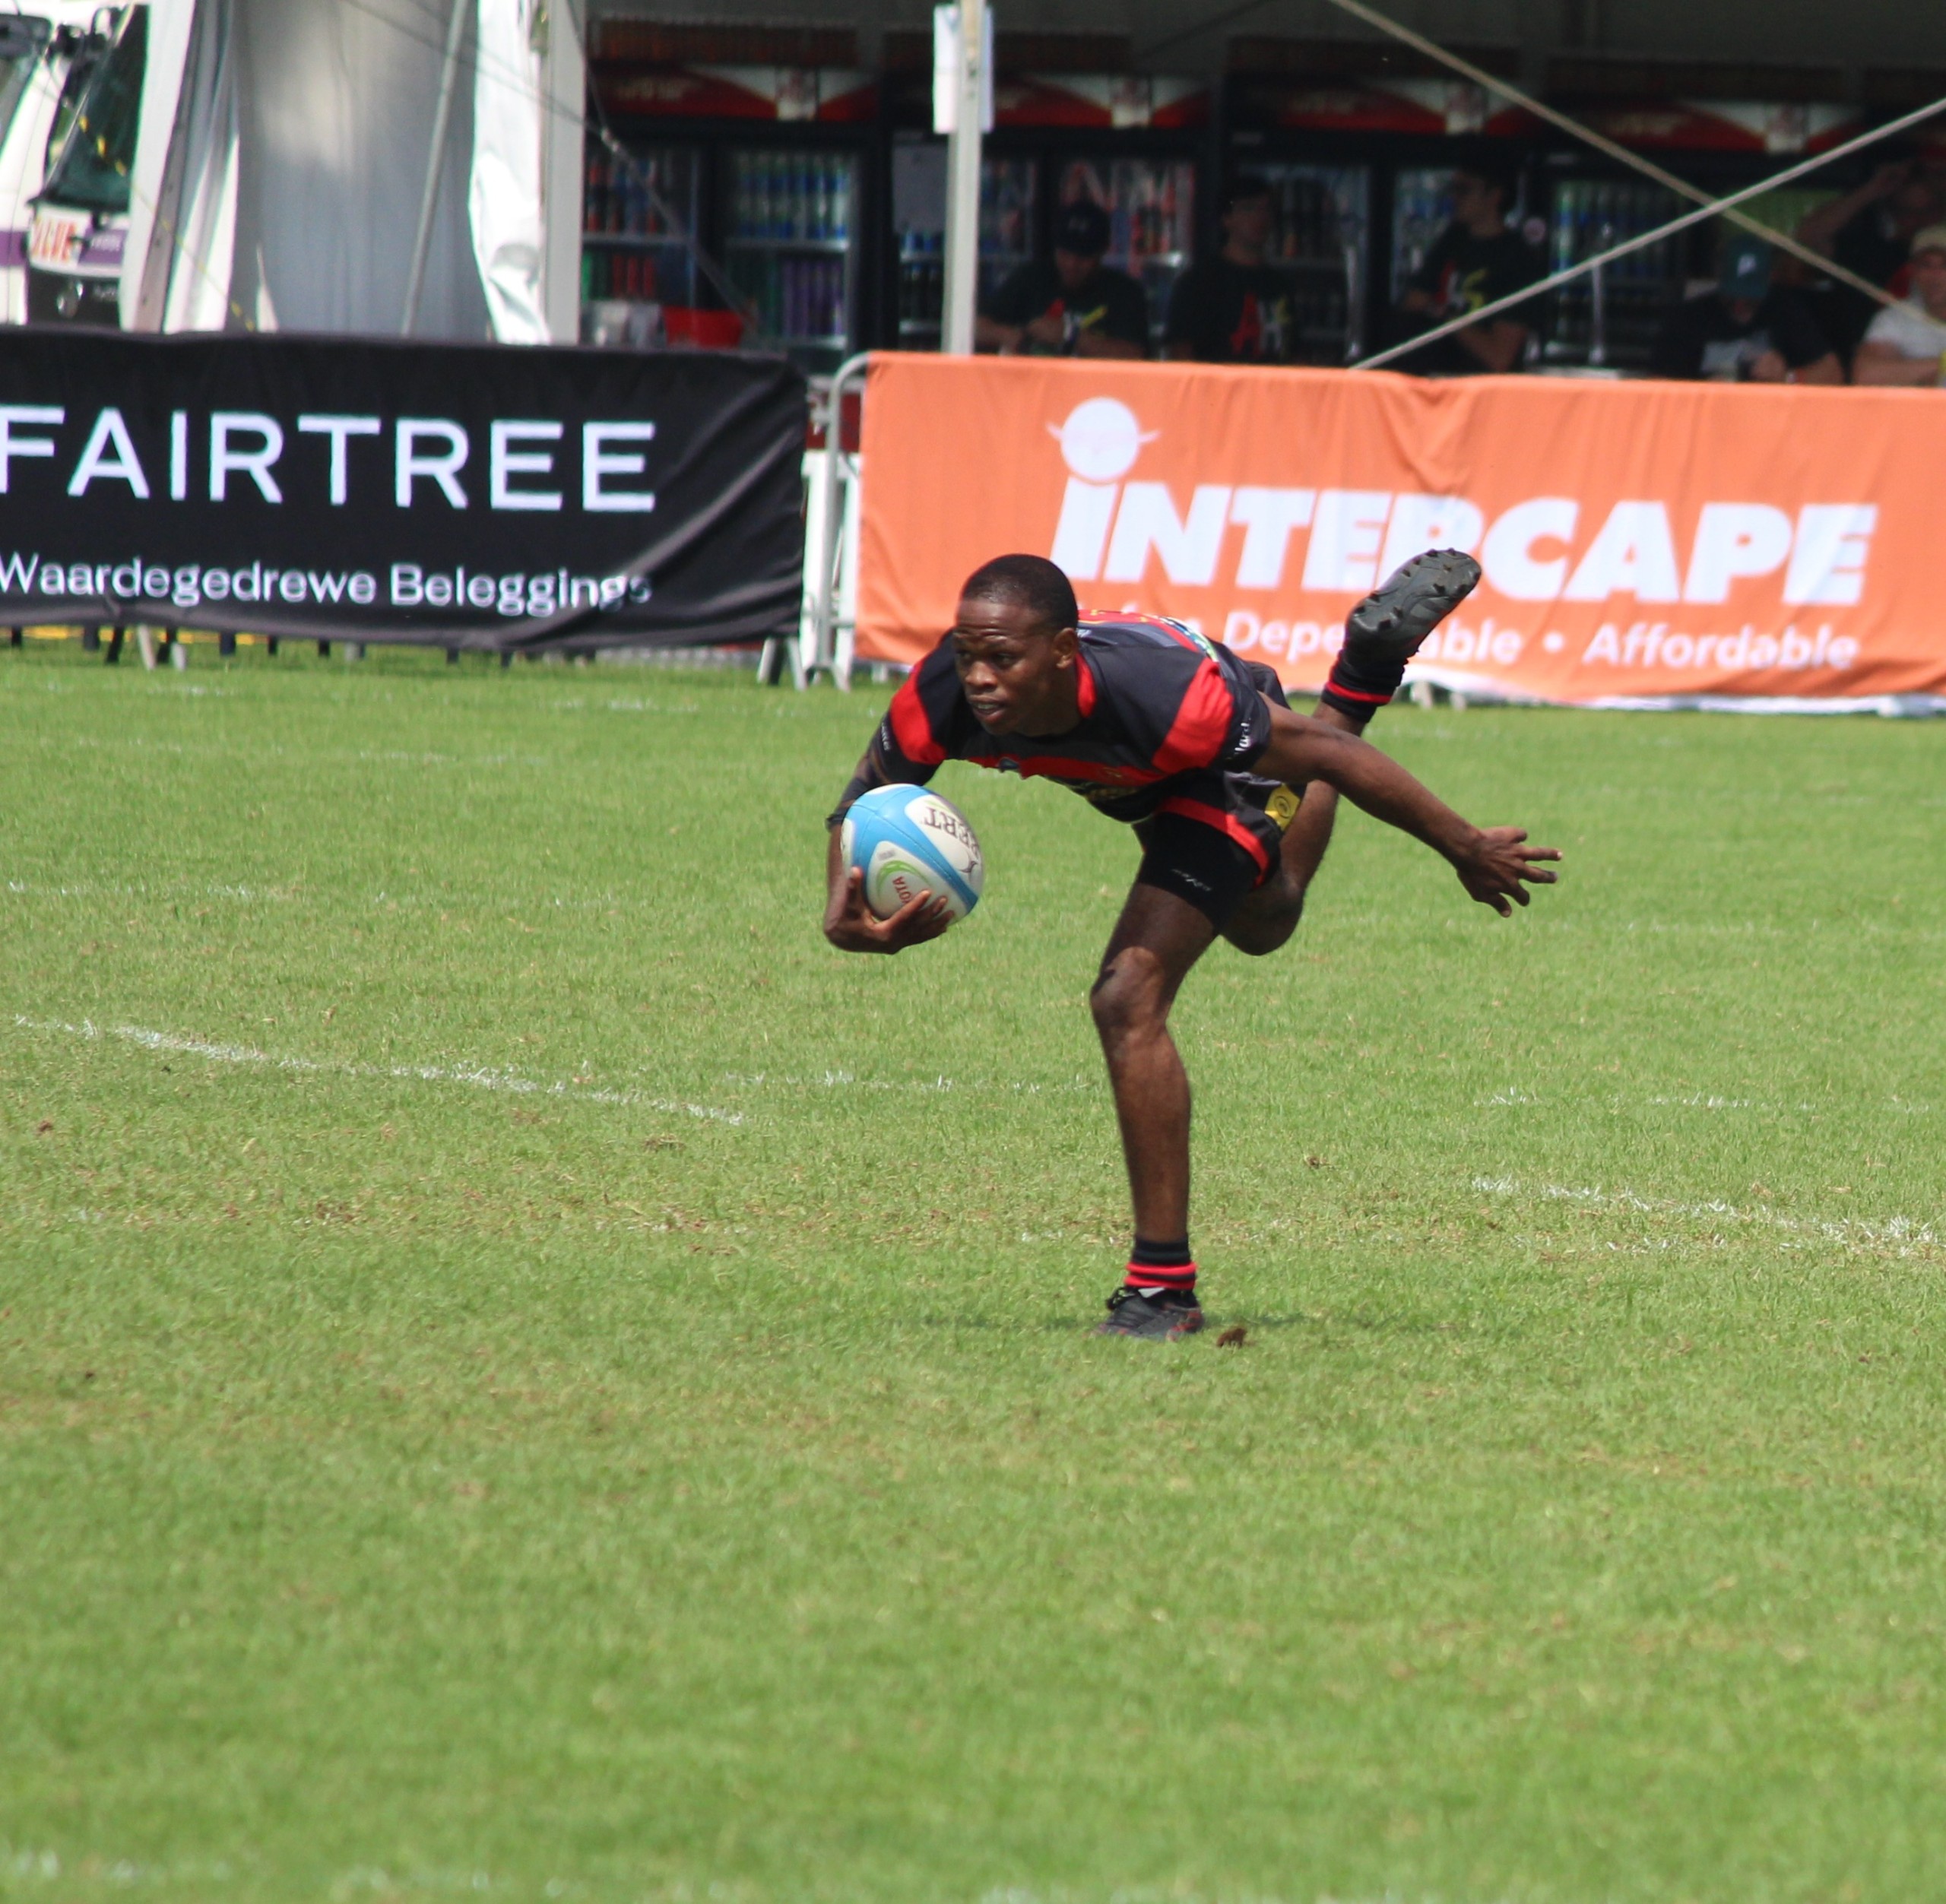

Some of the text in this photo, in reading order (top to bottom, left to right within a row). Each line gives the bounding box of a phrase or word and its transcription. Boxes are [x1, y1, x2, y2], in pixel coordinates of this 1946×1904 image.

[0, 404, 656, 512] FAIRTREE
[0, 550, 652, 618] Waardegedrewe Beleggings
[1222, 610, 1523, 666] Depeable
[1581, 622, 1860, 671] Affordable
